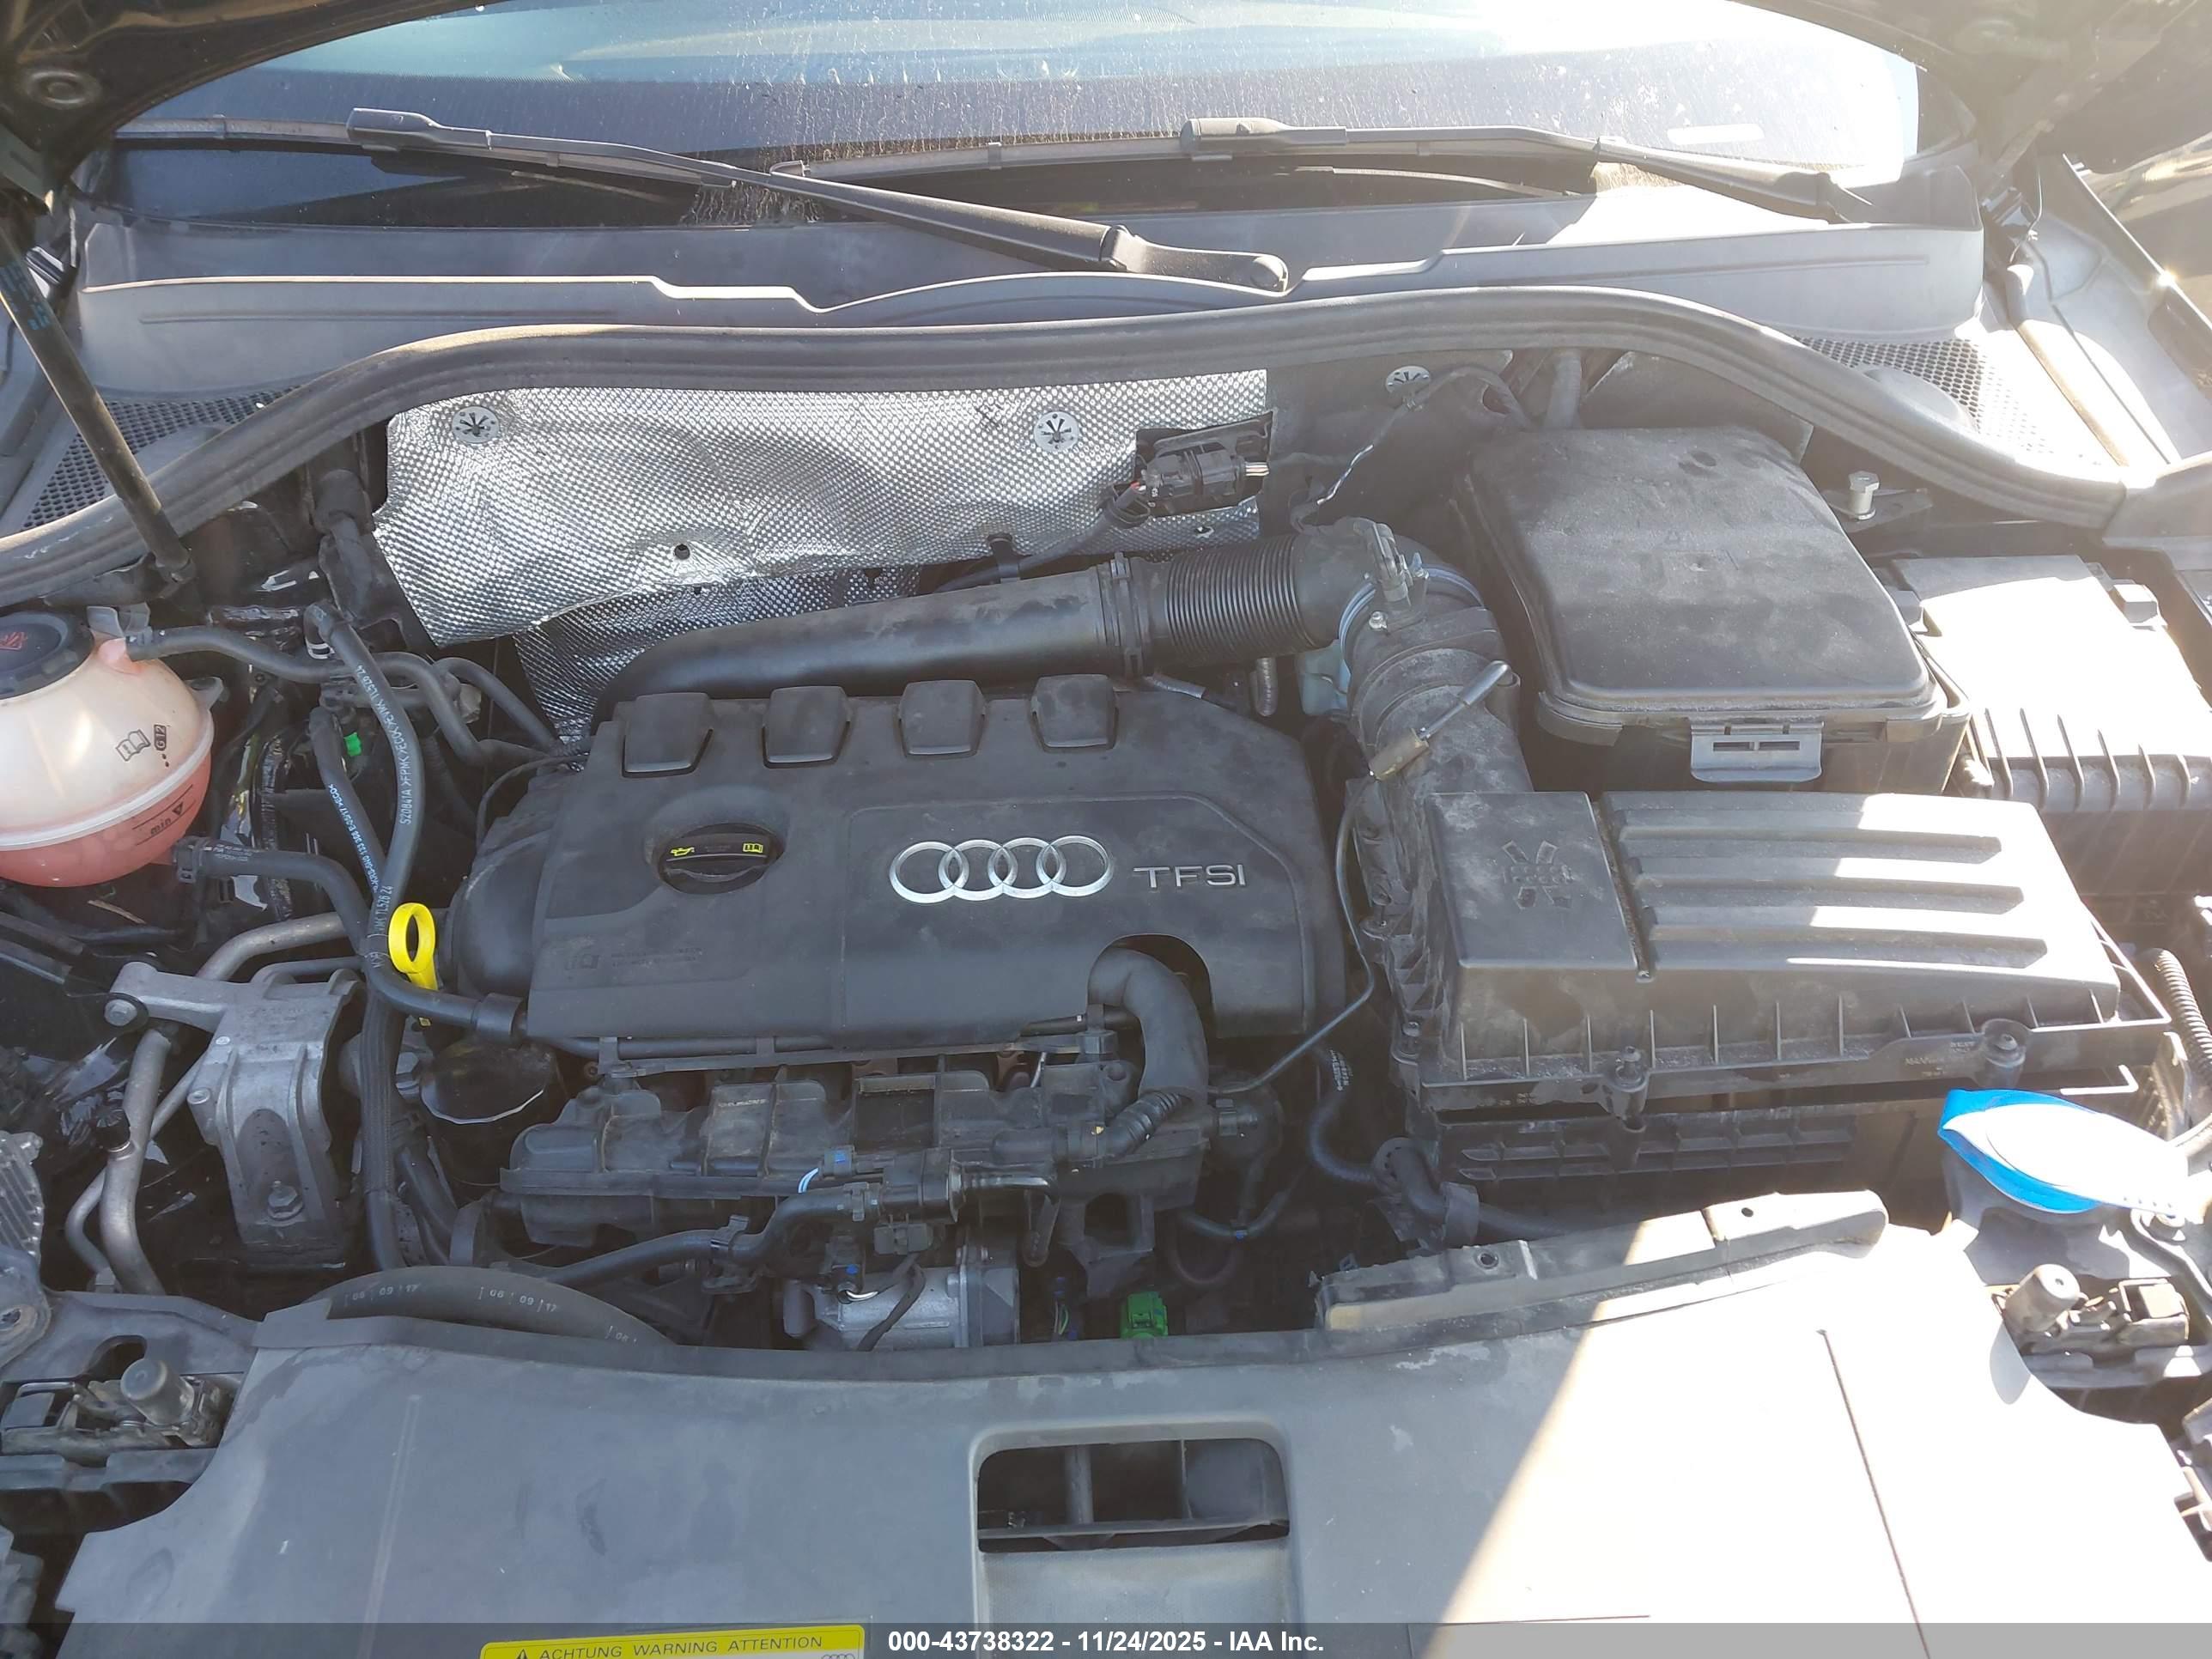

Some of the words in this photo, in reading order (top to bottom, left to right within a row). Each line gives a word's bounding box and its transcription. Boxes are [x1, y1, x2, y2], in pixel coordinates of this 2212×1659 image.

[155, 726, 166, 749] G12
[150, 816, 173, 835] min
[1133, 863, 1247, 889] TFSI
[519, 1295, 535, 1305] 09
[540, 1645, 623, 1659] ACHTUNG
[634, 1641, 718, 1656] WARNING
[728, 1637, 823, 1651] ATTENTION
